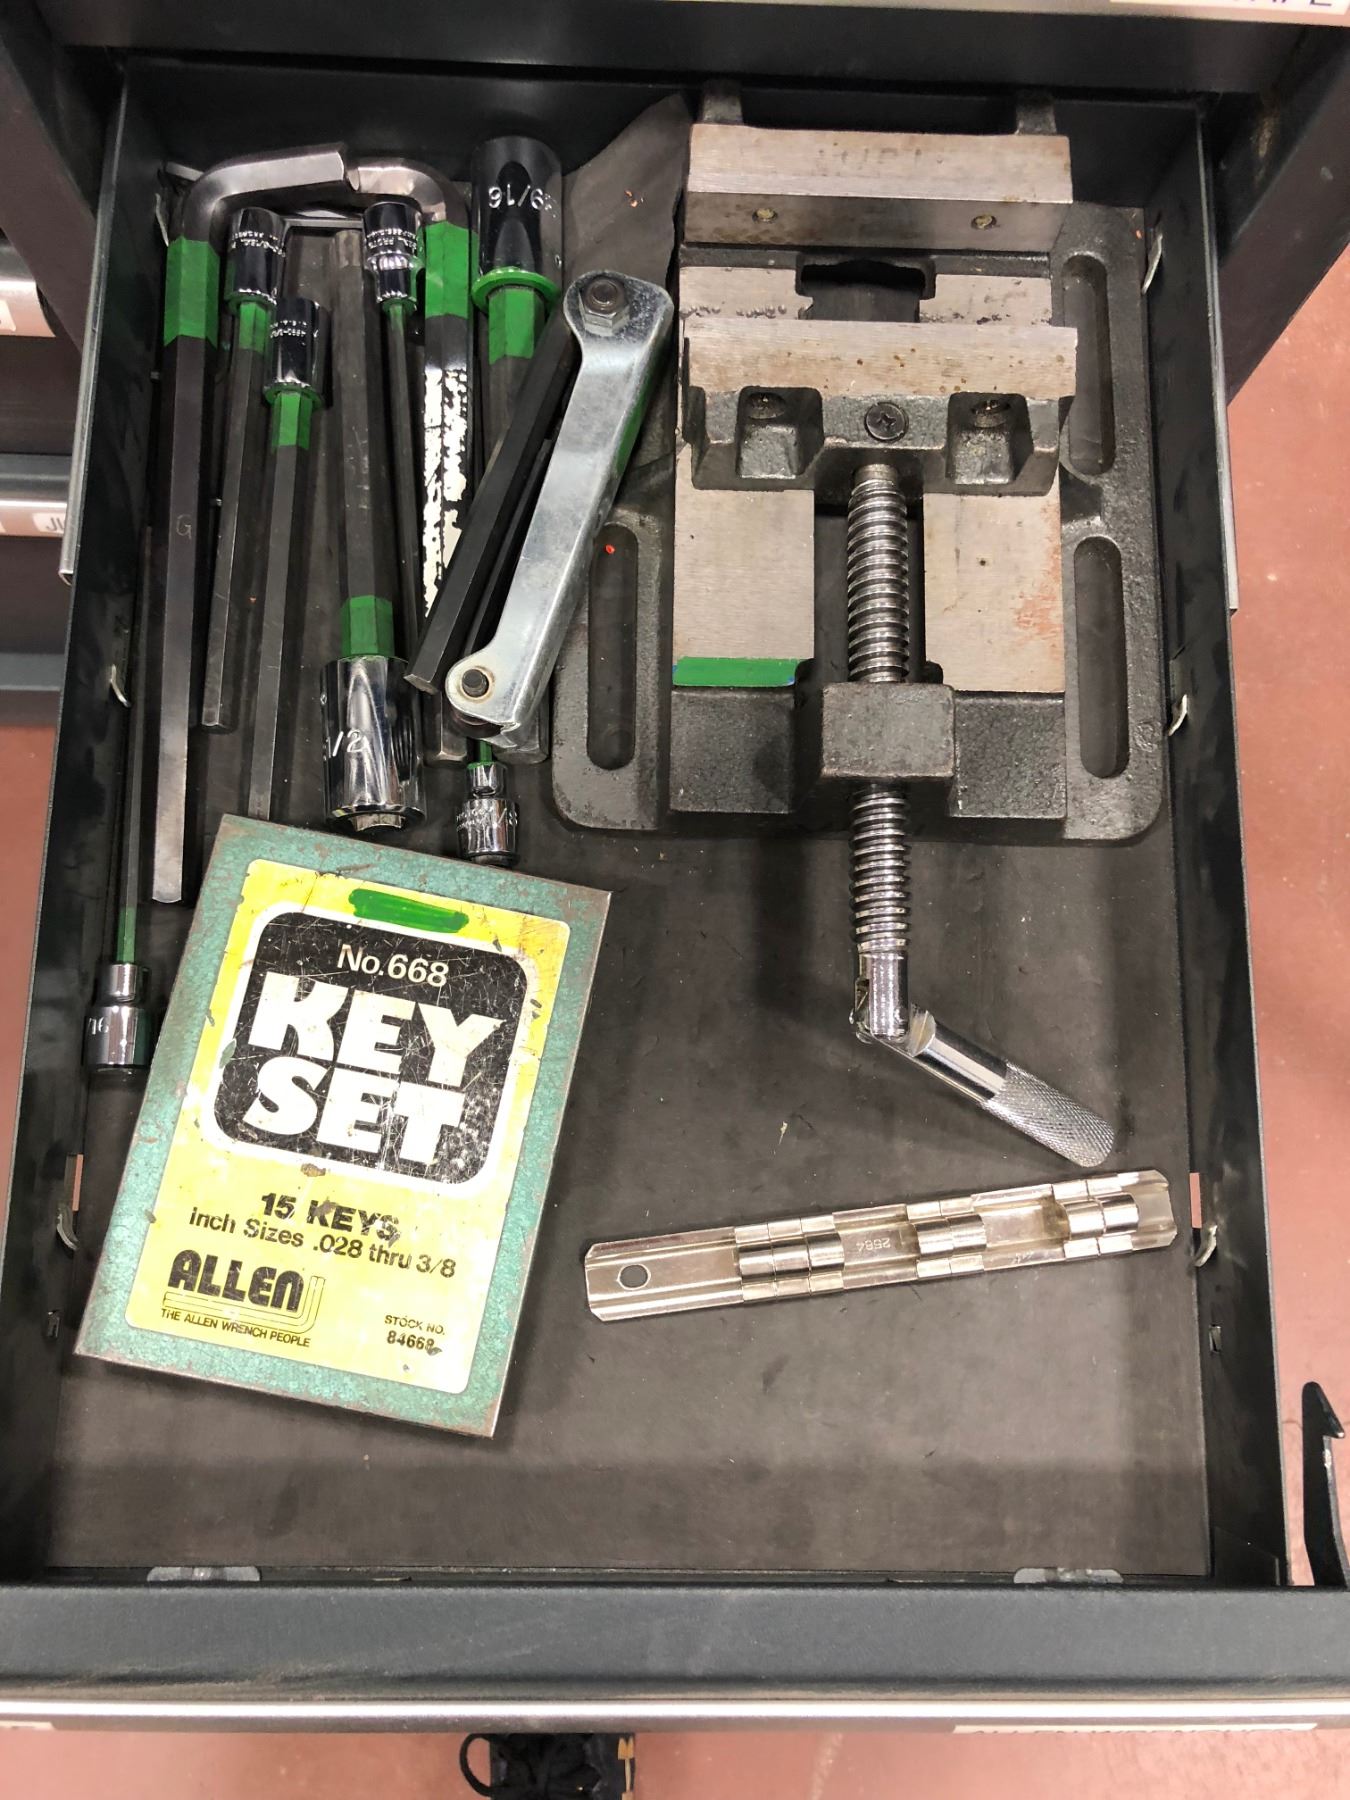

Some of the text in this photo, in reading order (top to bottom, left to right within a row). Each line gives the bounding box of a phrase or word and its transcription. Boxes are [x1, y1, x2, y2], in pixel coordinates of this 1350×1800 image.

[247, 970, 507, 1088] KEY
[241, 1055, 466, 1165] SET
[261, 1192, 297, 1220] 15
[189, 1206, 457, 1278] inch Sizes .028 thru 3/8
[167, 1248, 305, 1313] ALLEN
[161, 1307, 311, 1348] THE ALLEN WRENCH PEOPLE
[384, 1314, 445, 1336] STOCK NO.
[386, 1330, 436, 1351] 84668
